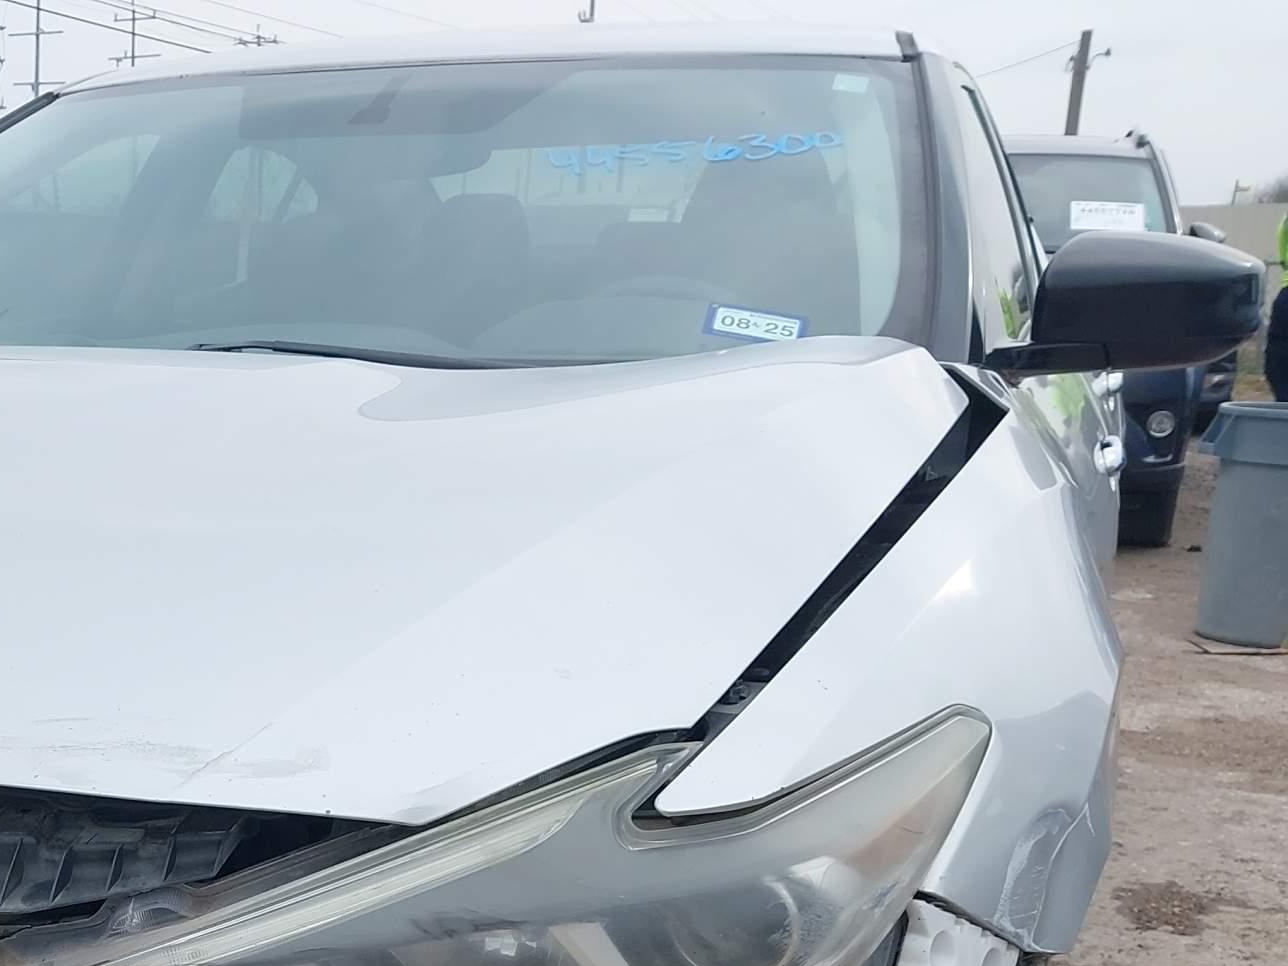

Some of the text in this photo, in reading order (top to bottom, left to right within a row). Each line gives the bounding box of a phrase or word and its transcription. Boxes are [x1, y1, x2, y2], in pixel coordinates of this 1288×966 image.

[546, 131, 844, 176] 44556300
[720, 315, 795, 337] 08 25
